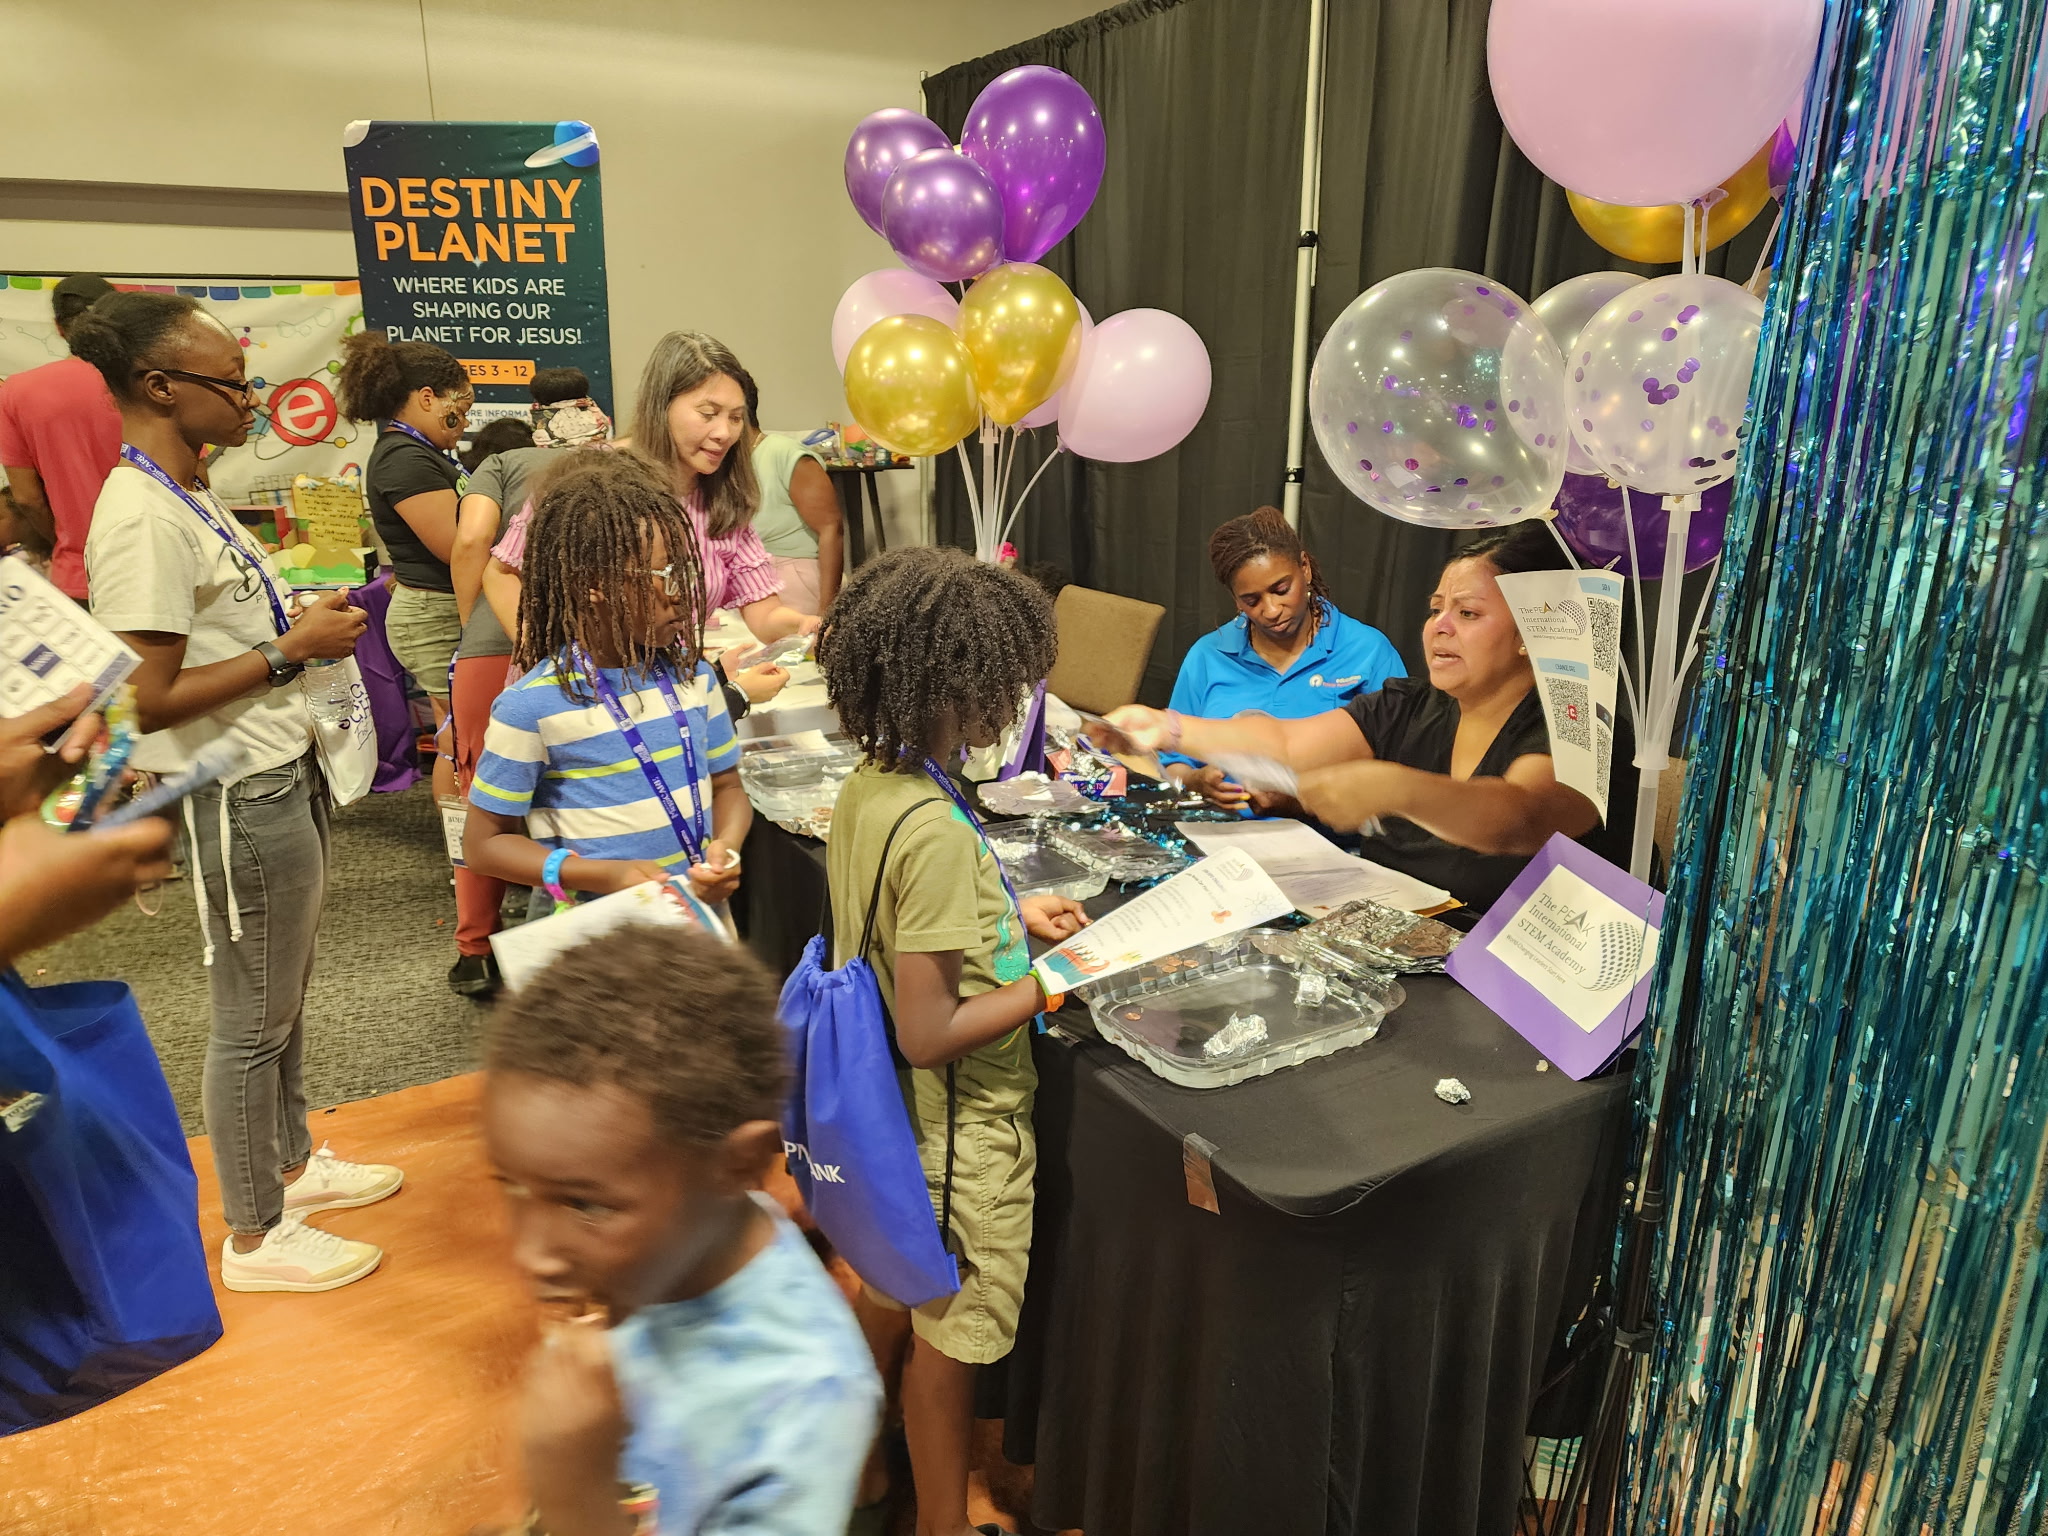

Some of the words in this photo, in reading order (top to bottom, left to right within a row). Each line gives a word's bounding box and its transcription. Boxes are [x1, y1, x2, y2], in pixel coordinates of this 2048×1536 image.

[360, 177, 582, 218] DESTINY
[374, 221, 576, 263] PLANET
[393, 277, 468, 294] WHERE
[472, 277, 518, 295] KIDS
[523, 278, 566, 296] ARE
[412, 301, 501, 319] SHAPING
[507, 302, 551, 320] OUR
[386, 325, 463, 343] PLANET
[469, 327, 511, 344] FOR
[516, 327, 582, 345] JESUS!
[461, 364, 487, 376] ES
[491, 365, 499, 376] 3
[513, 365, 528, 377] 12
[486, 409, 528, 417] INFORMA
[1526, 625, 1547, 633] STEM
[1550, 625, 1579, 635] Academy
[1539, 893, 1558, 911] The
[1557, 905, 1595, 937] PEAK
[1529, 904, 1587, 951] International
[1518, 918, 1547, 943] STEM
[1544, 940, 1586, 975] Academy
[810, 1160, 846, 1184] ANK
